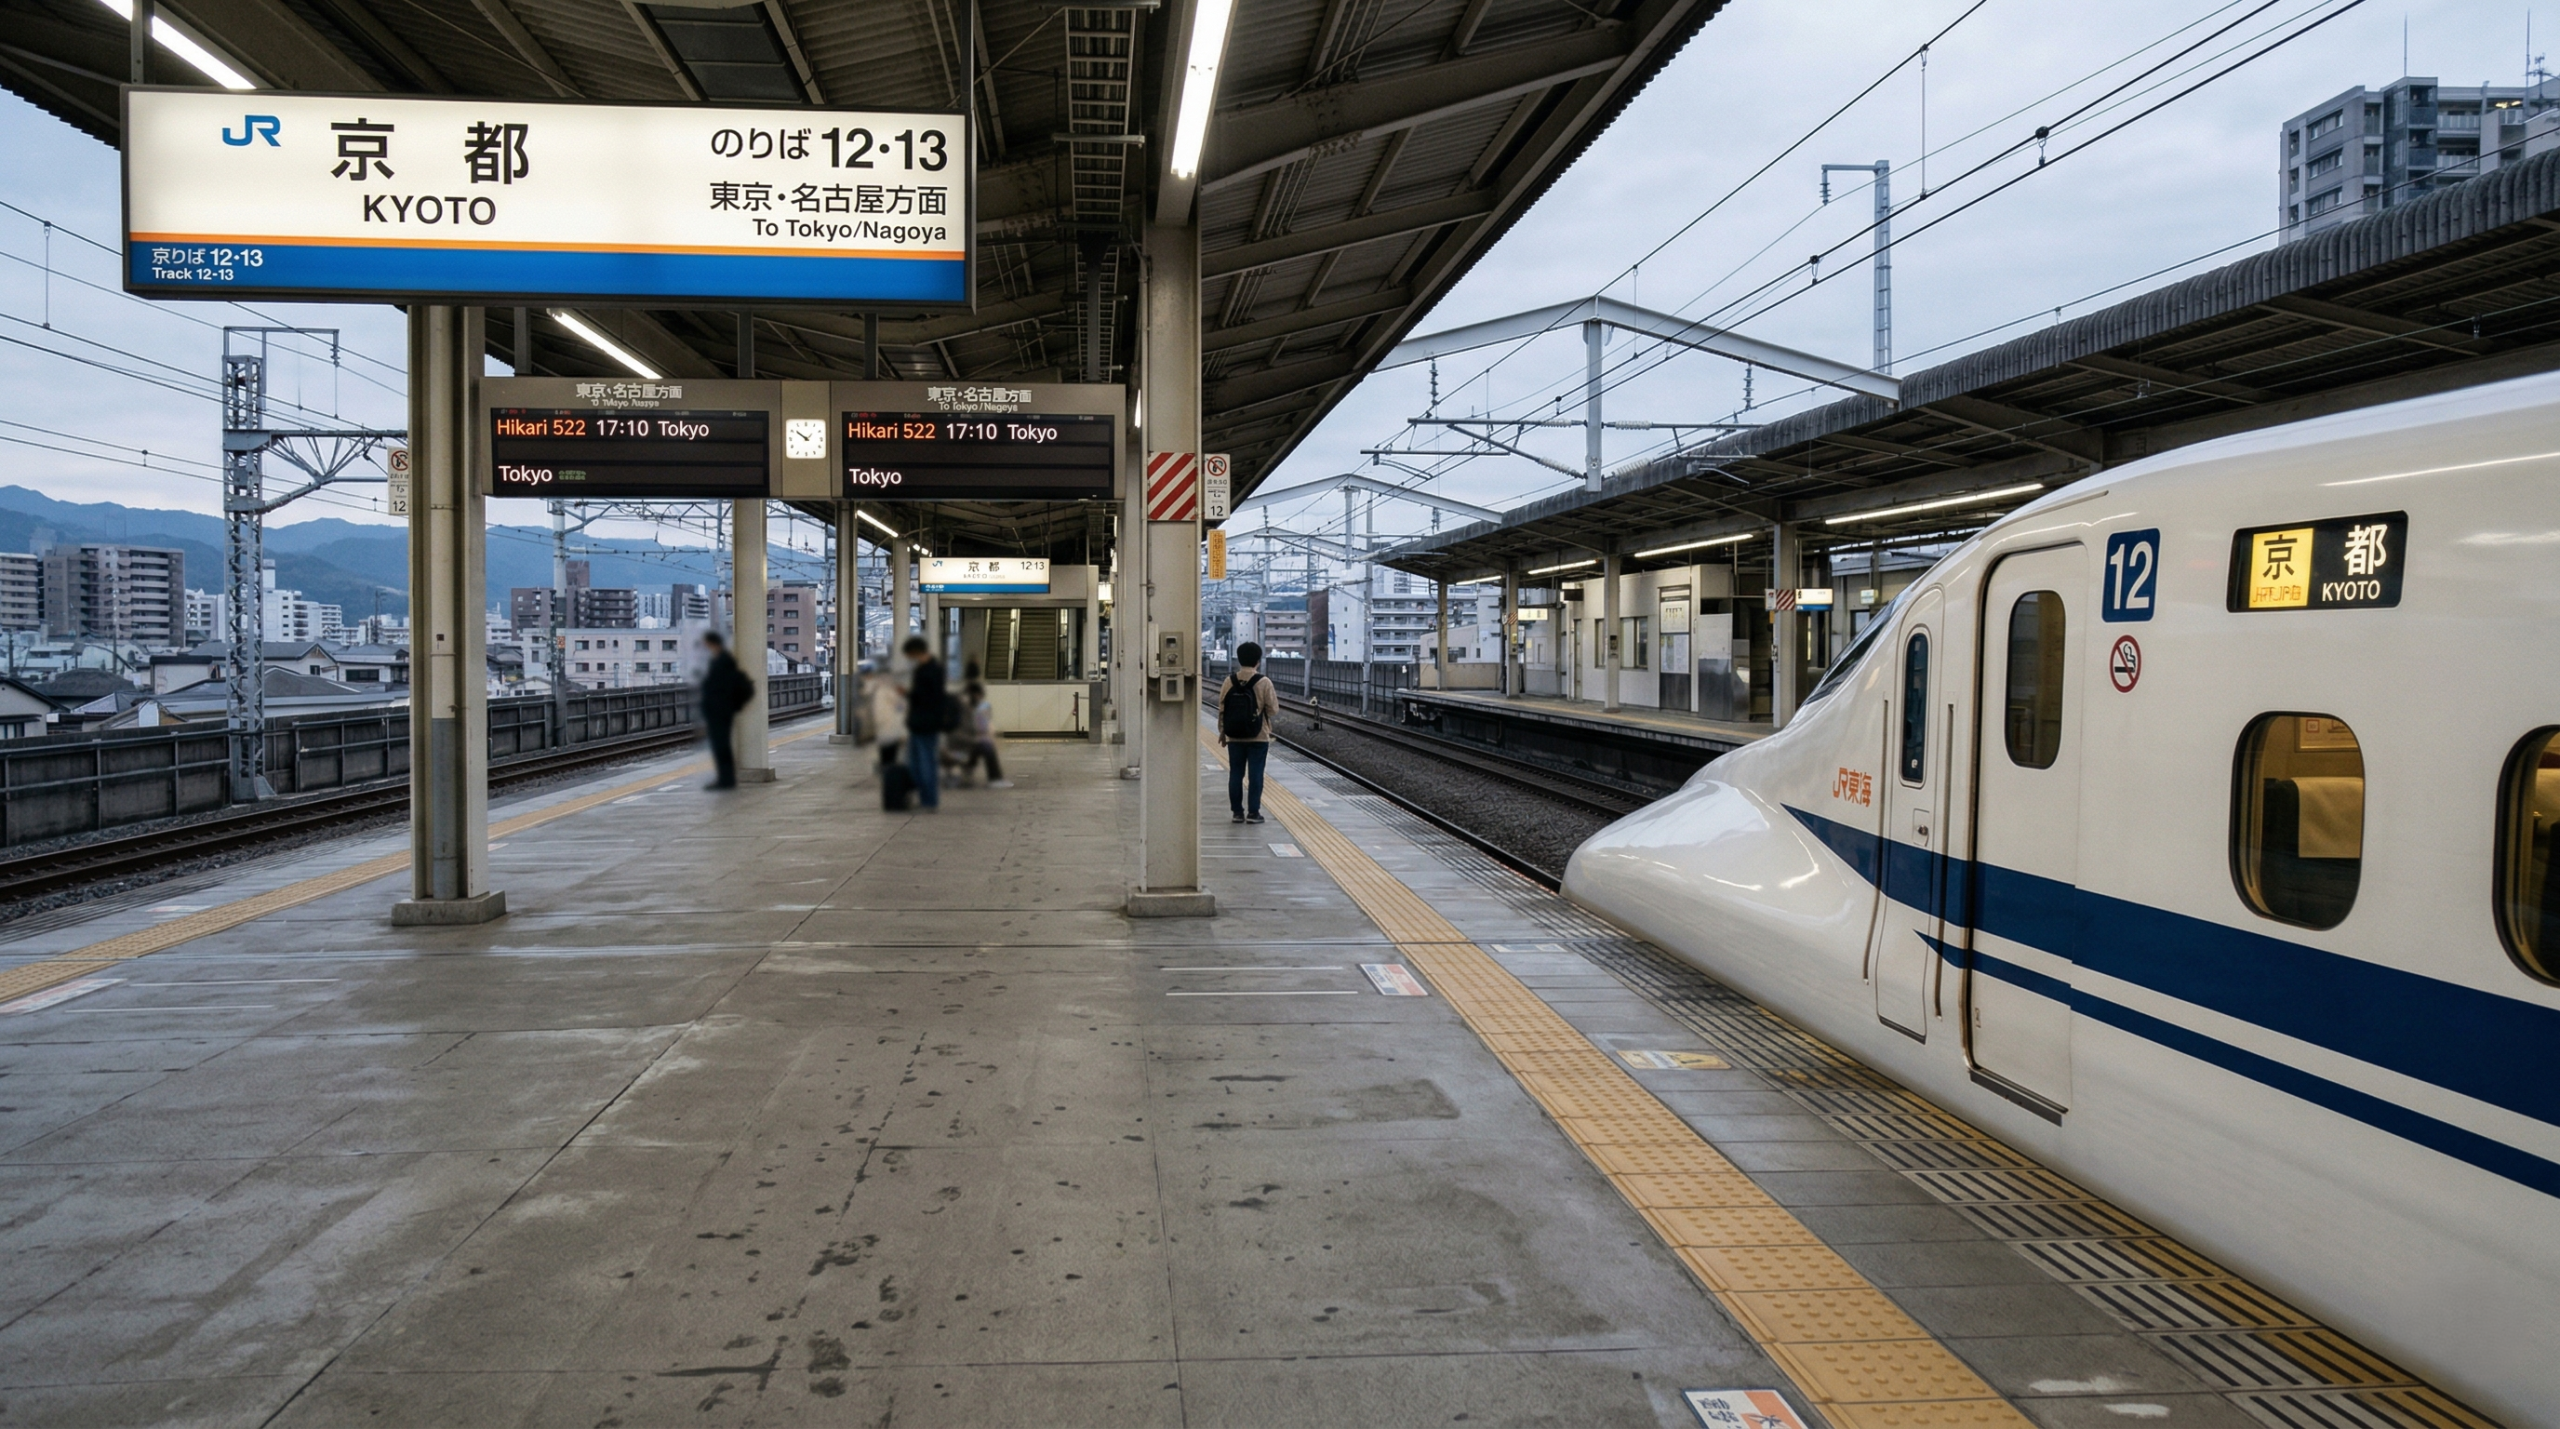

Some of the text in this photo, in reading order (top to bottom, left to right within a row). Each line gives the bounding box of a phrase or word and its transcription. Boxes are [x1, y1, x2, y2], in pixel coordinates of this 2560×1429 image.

[222, 115, 281, 147] JR
[711, 128, 812, 160] のりば
[709, 181, 948, 216] 東京・名古屋方面
[363, 194, 496, 226] KYOTO
[752, 218, 947, 244] To Tokyo/Nagoya
[151, 247, 206, 265] 京りば
[151, 267, 235, 281] Track 12-13
[497, 419, 710, 440] Hikari 522 17:10 Tokyo
[848, 423, 1058, 443] Hikari 522 17:10 Tokyo
[498, 465, 553, 486] Tokyo
[849, 468, 902, 488] Tokyo
[393, 501, 406, 512] 12
[1210, 505, 1224, 517] 12
[2110, 541, 2153, 609] 12
[2321, 580, 2381, 602] KYOTO
